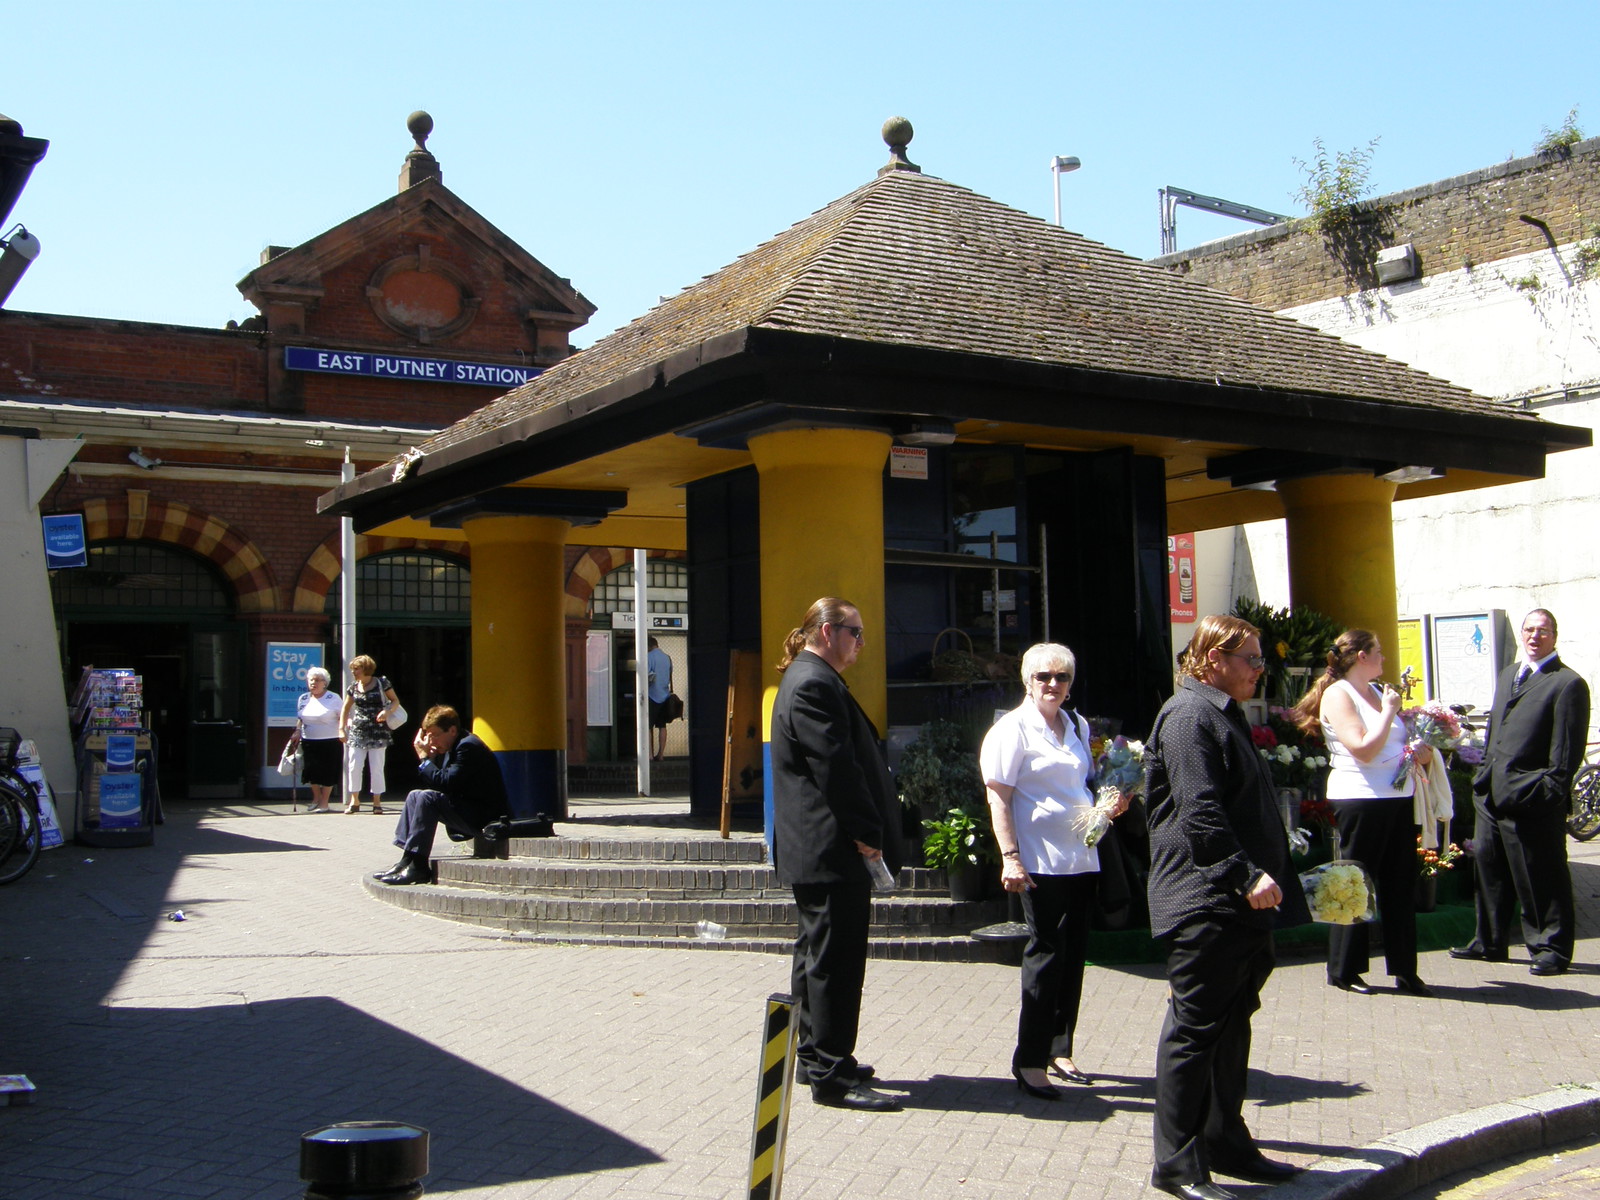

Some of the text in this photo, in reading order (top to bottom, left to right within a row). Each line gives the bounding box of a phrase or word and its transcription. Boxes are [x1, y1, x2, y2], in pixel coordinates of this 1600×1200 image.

[318, 353, 527, 384] EAST PUTNEY STATION
[891, 447, 926, 456] WARNING
[50, 533, 80, 541] available
[1171, 608, 1193, 617] Phones
[273, 650, 307, 665] Stay
[272, 684, 309, 692] in the he
[105, 783, 134, 792] oyster
[106, 792, 136, 800] available
